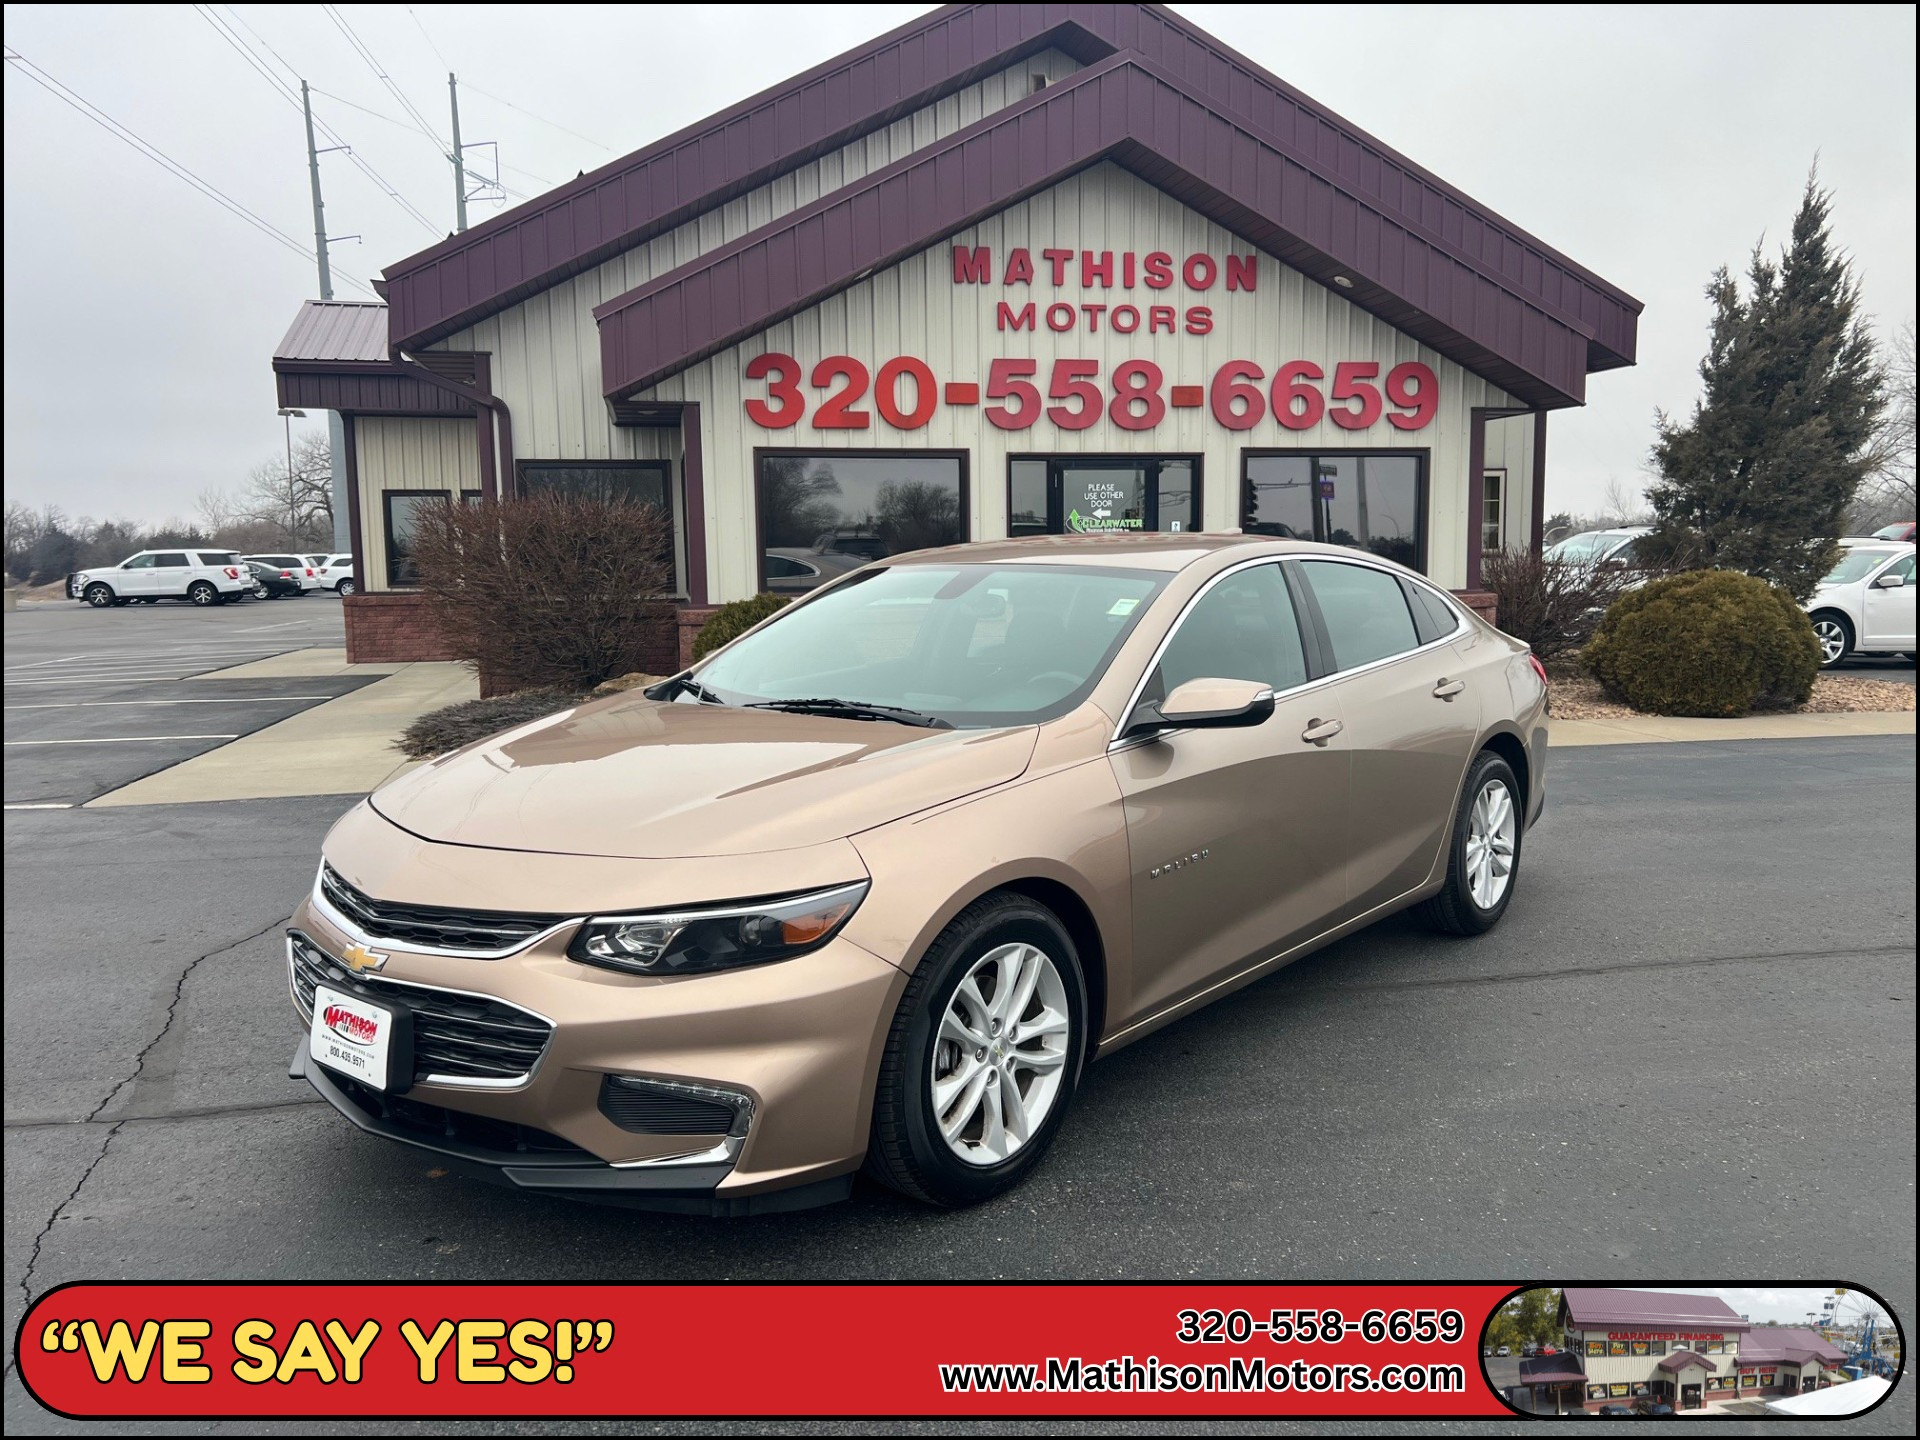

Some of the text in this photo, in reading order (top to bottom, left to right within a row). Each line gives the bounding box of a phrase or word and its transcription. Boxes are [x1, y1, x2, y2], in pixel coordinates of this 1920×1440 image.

[953, 245, 1257, 291] MATHISON
[997, 301, 1214, 335] MOTORS
[745, 353, 1439, 431] 320-558-6659
[1084, 491, 1124, 500] USE OTHER
[1083, 519, 1143, 528] CLEARWATER
[1151, 849, 1208, 879] MALIBU
[326, 1006, 378, 1036] MATHISON
[349, 1027, 375, 1042] MOTORS
[330, 1046, 365, 1068] 800.435.9571
